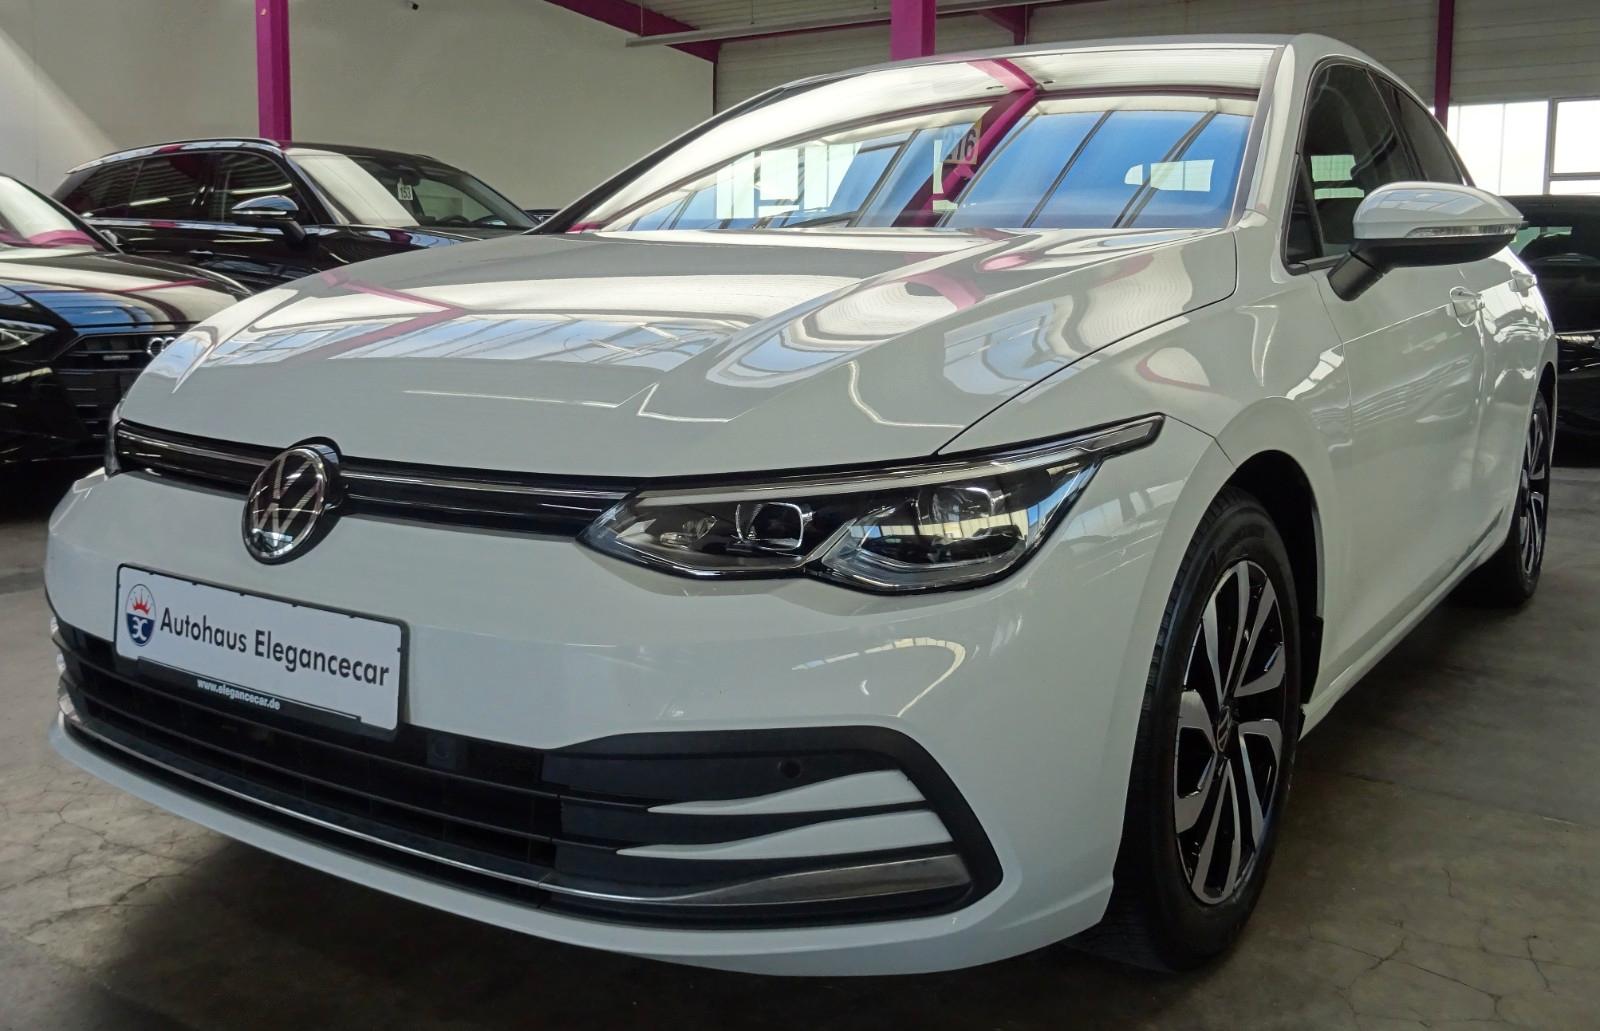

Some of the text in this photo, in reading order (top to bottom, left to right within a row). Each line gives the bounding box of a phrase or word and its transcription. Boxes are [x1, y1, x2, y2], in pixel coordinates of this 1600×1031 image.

[160, 607, 390, 687] Autohaus Elegancecar
[197, 679, 281, 711] www.elegancecar.de
